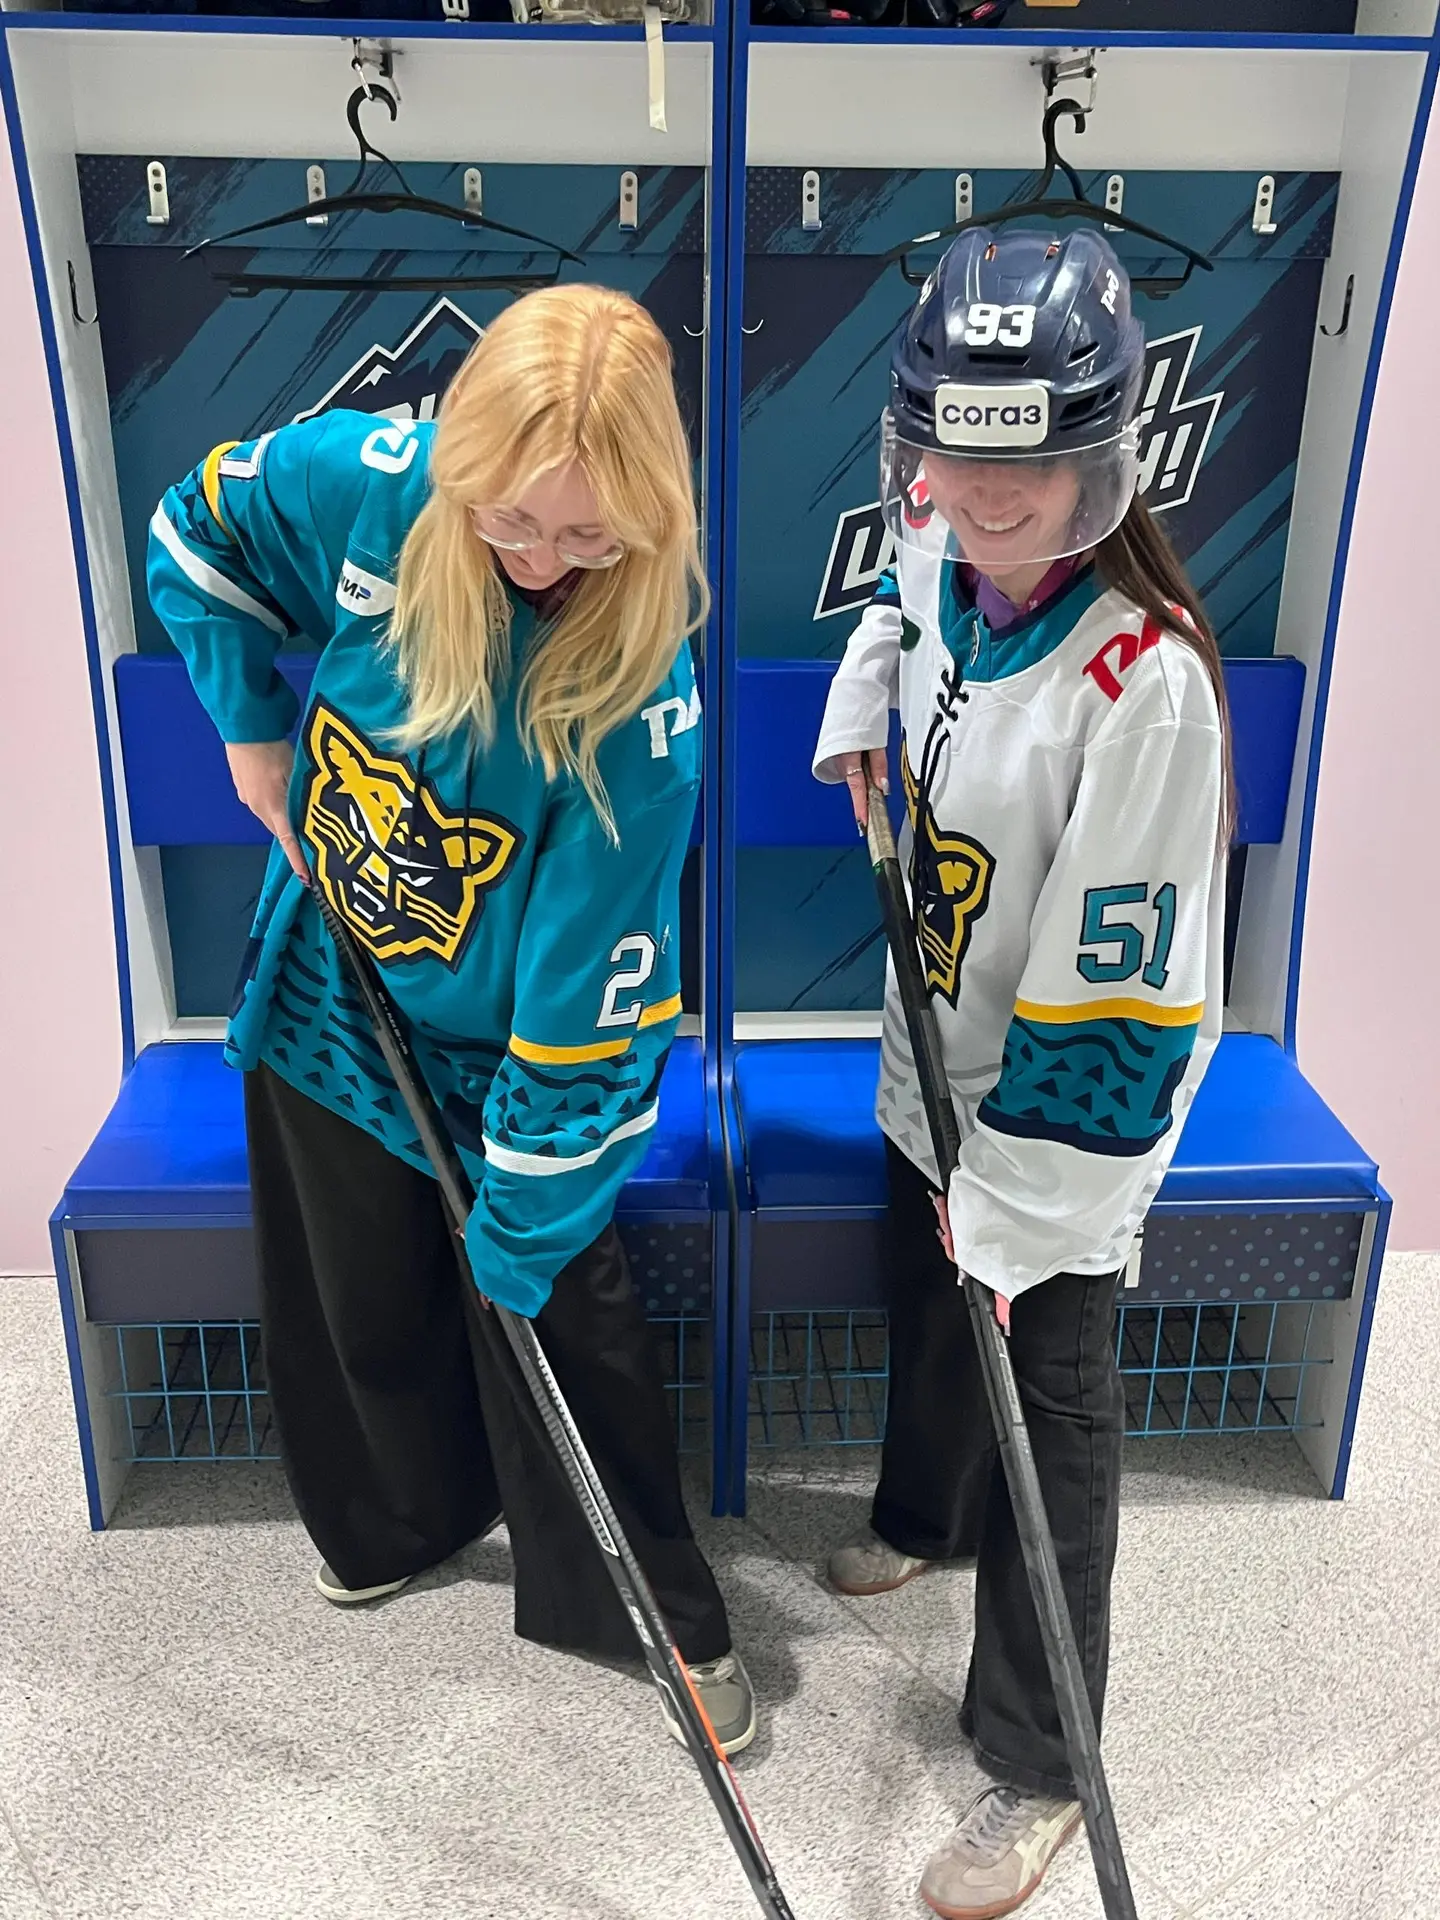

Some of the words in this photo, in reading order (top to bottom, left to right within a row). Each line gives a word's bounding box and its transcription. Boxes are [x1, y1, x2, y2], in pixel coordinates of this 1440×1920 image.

[964, 303, 1037, 347] 93
[941, 404, 1042, 427] согаз
[1076, 882, 1176, 991] 51
[594, 924, 670, 1030] 2
